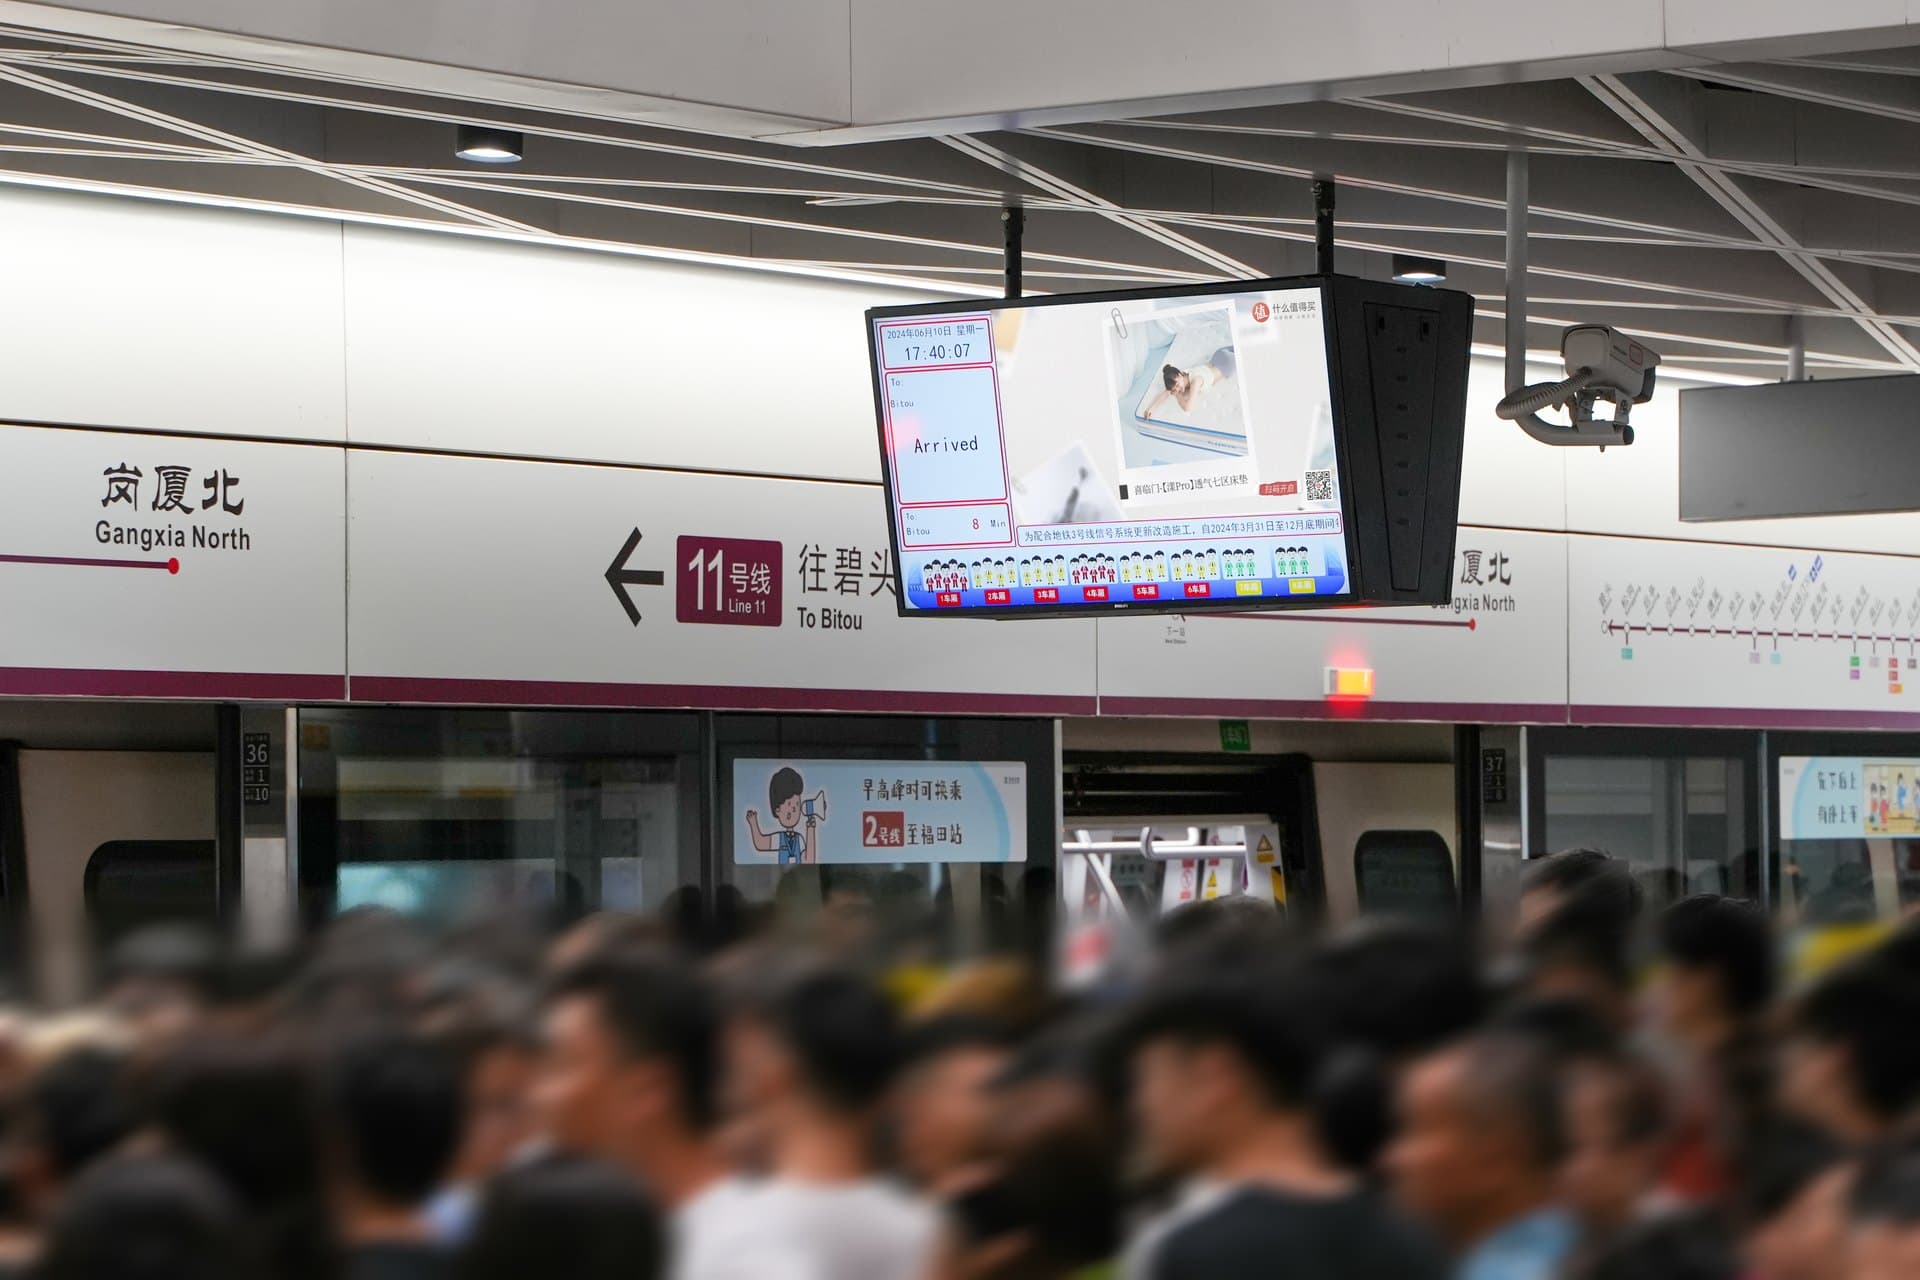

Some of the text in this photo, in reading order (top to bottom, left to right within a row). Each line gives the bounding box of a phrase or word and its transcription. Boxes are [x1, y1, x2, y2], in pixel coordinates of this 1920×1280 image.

[1273, 301, 1316, 313] 什么值得买
[905, 343, 970, 360] 17:40:07
[891, 400, 914, 408] Bitou
[914, 435, 978, 453] Arrived
[101, 462, 244, 516] 岗厦北
[906, 527, 930, 536] Bitou
[972, 519, 1006, 529] 8 Min
[95, 520, 250, 551] Gangxia North
[798, 543, 896, 597] 往碧头
[729, 598, 766, 615] Line 11
[1483, 594, 1515, 612] North
[797, 607, 862, 630] To Bitou
[247, 743, 268, 763] 36
[1485, 756, 1503, 772] 37
[258, 769, 265, 782] 1
[255, 787, 269, 800] 10
[863, 778, 962, 800] 早高峰时可换乘
